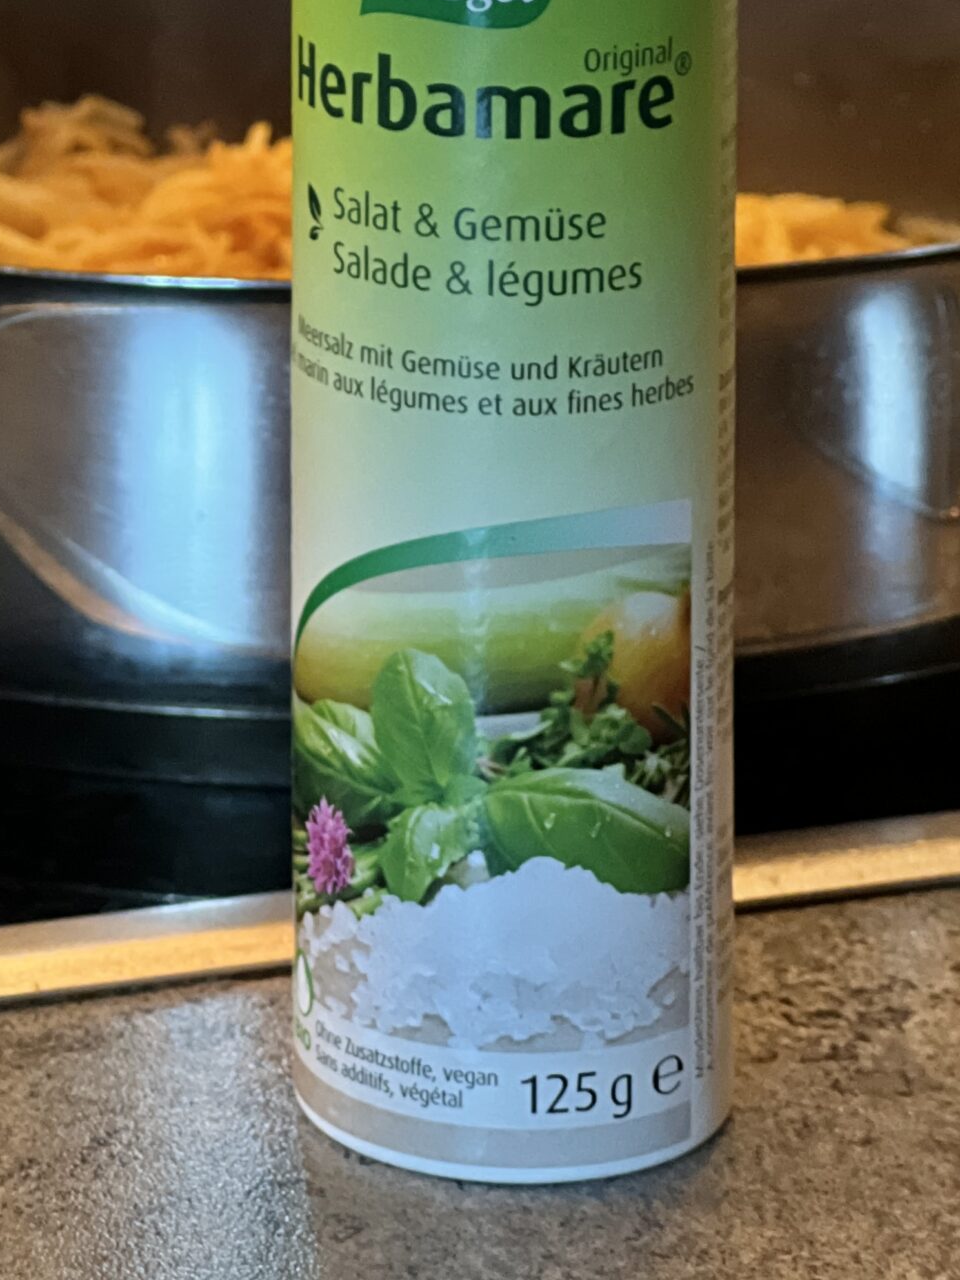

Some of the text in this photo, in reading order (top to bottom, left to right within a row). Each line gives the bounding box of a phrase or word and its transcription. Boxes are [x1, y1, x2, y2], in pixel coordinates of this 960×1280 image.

[584, 36, 673, 77] Original
[333, 186, 607, 242] Salat & Gemüse
[333, 241, 642, 307] Salade & légumes
[360, 341, 394, 369] mit
[401, 349, 500, 380] Gemüse
[510, 355, 558, 380] und
[568, 348, 663, 379] Kräutern
[333, 371, 364, 399] aux
[370, 377, 468, 414] légumes
[478, 394, 503, 416] et
[512, 394, 558, 416] aux
[568, 389, 624, 415] fines
[631, 372, 694, 407] herbes
[399, 1082, 465, 1109] végétal
[443, 1066, 499, 1091] vegan
[520, 1072, 598, 1115] 125
[610, 1072, 634, 1119] g
